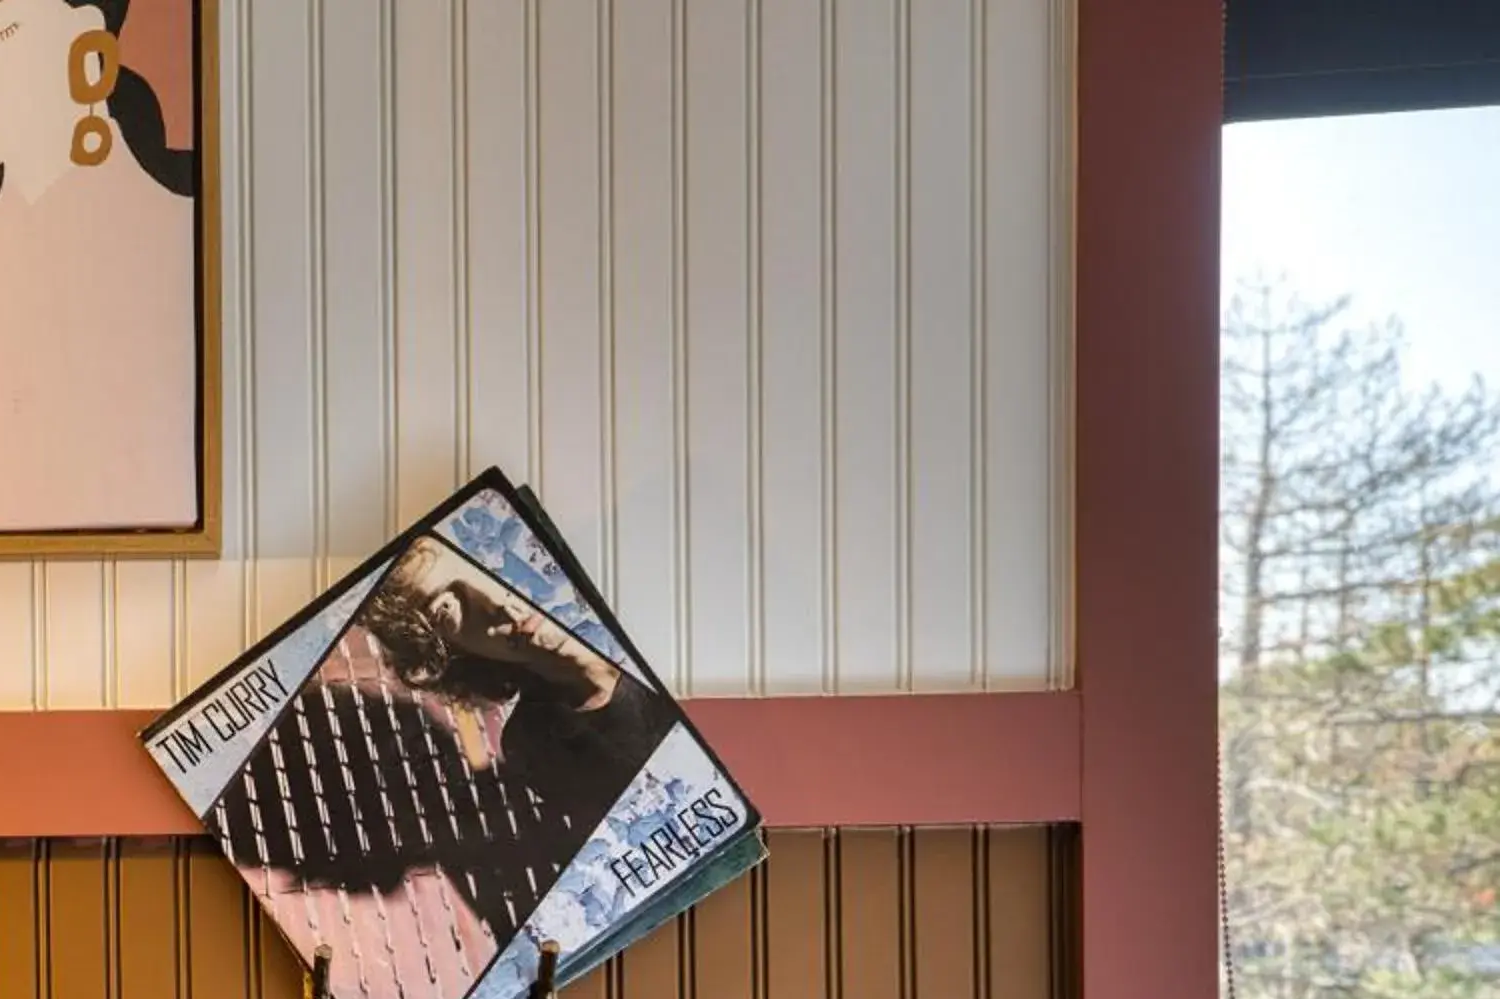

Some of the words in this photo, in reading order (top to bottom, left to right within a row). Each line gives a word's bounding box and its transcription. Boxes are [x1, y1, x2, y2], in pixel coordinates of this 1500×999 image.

[155, 719, 213, 774] TIM
[201, 658, 289, 742] CURRY
[610, 787, 739, 898] FEARLESS
